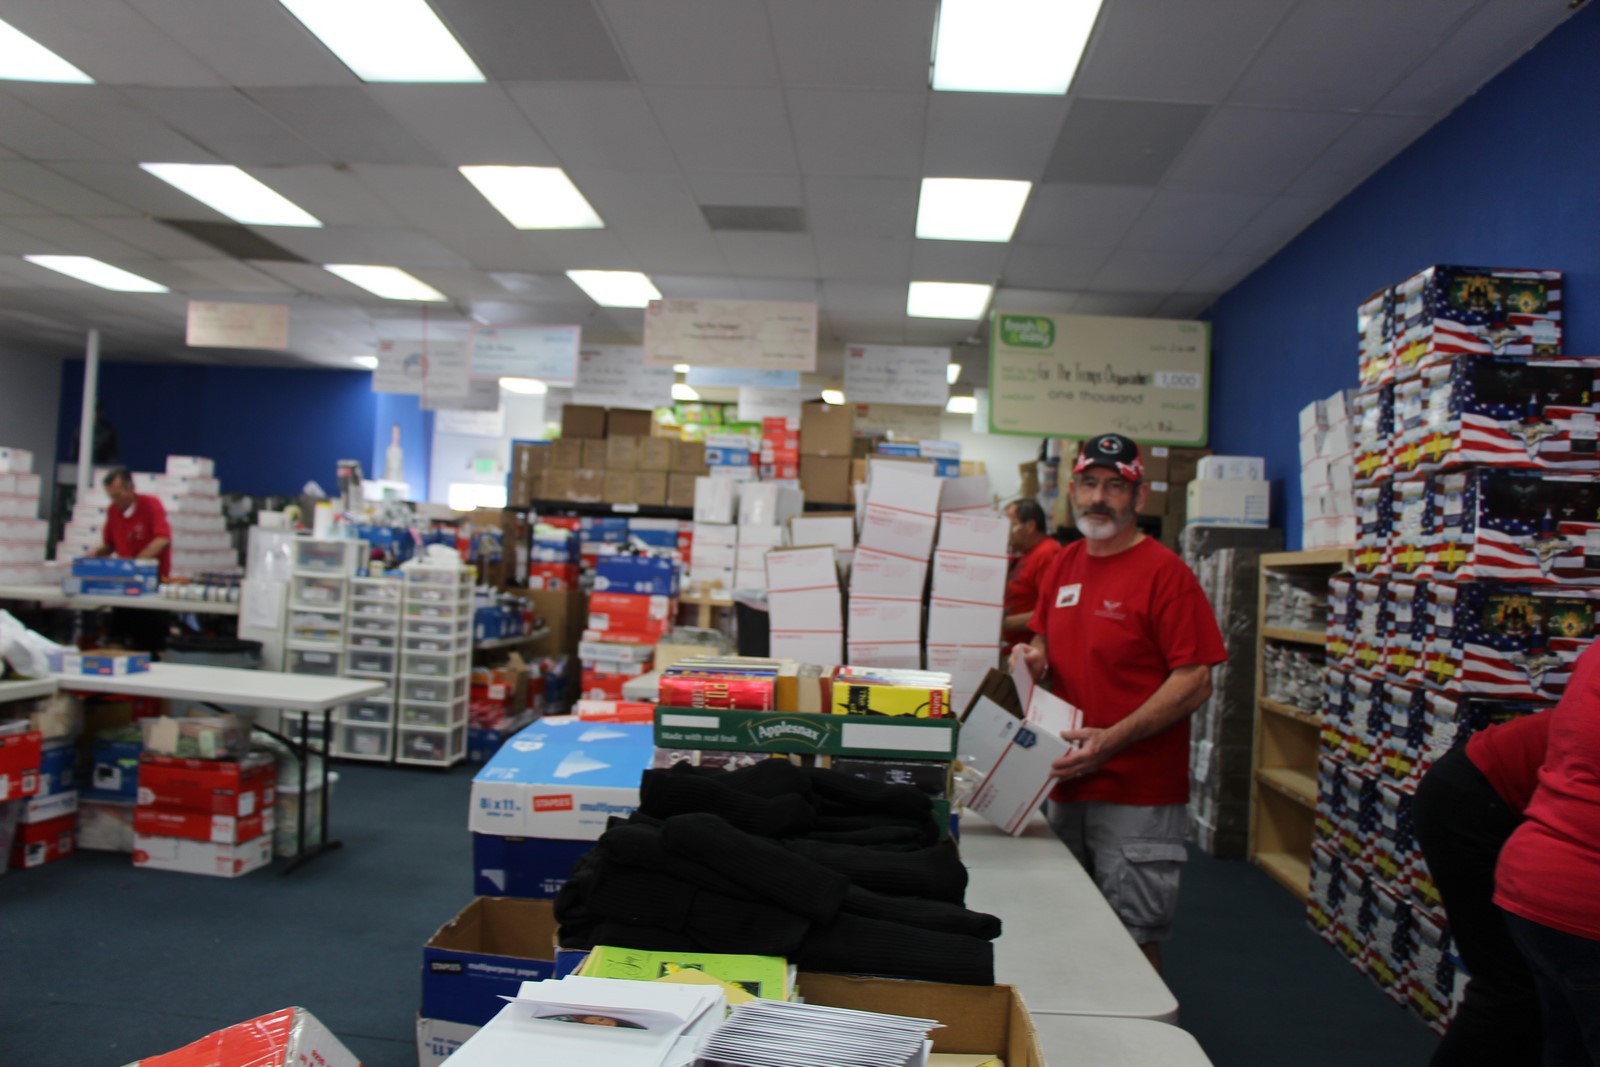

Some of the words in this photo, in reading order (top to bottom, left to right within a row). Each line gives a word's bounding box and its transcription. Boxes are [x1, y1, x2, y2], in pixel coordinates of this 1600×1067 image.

[1048, 389, 1075, 399] one
[1080, 390, 1144, 404] thousand
[932, 693, 942, 715] John
[661, 732, 682, 741] Made
[685, 733, 702, 742] with
[704, 734, 719, 743] real
[720, 735, 738, 744] fruit
[758, 721, 820, 741] Applesnax
